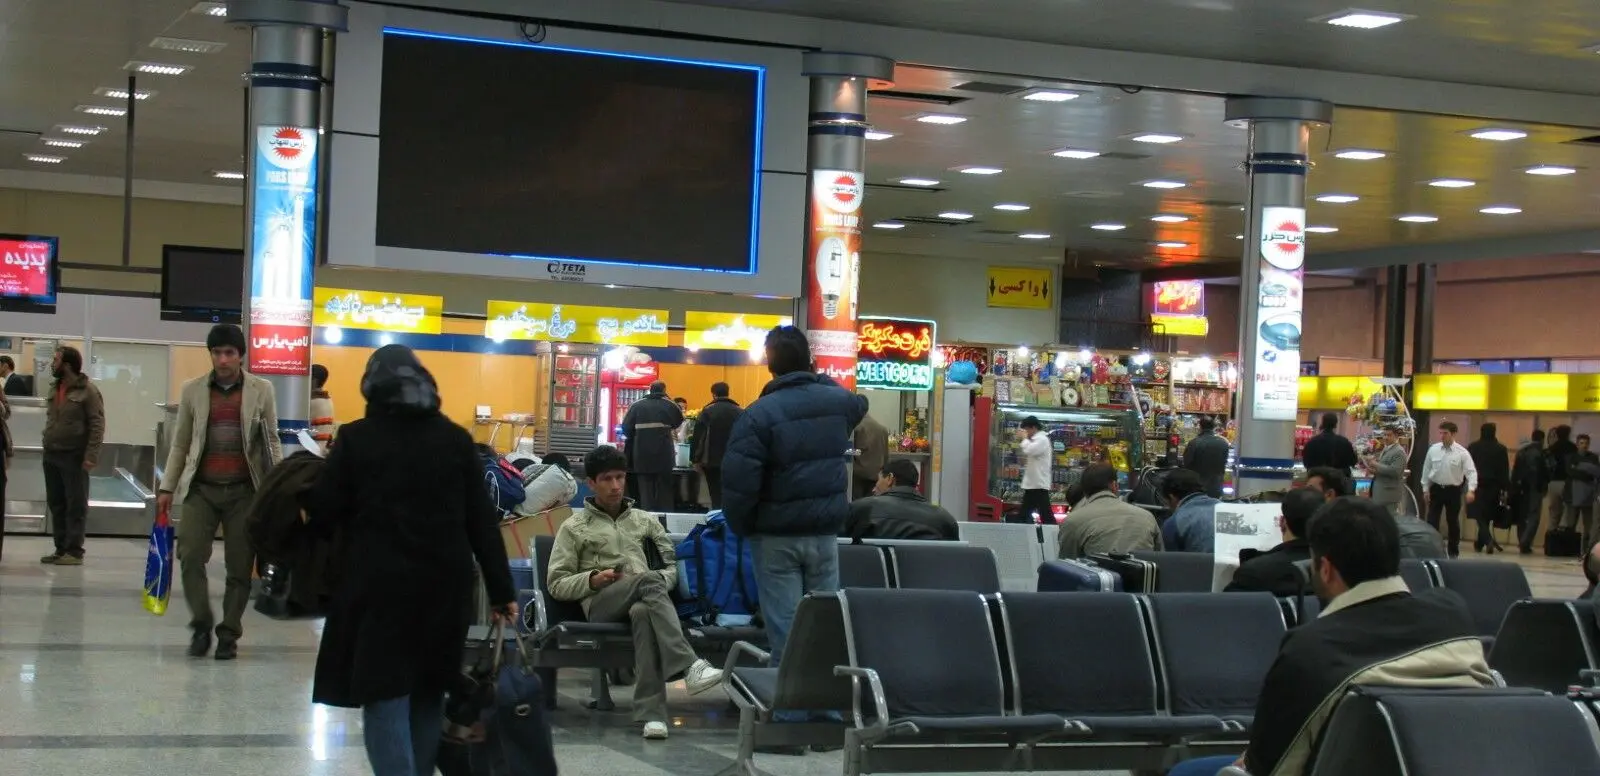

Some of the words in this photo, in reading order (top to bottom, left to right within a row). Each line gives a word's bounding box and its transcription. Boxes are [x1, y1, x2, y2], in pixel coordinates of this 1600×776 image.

[5, 252, 46, 275] پدیده
[562, 263, 586, 272] TETA
[548, 304, 577, 339] مرغ
[856, 361, 931, 386] WEETCORN
